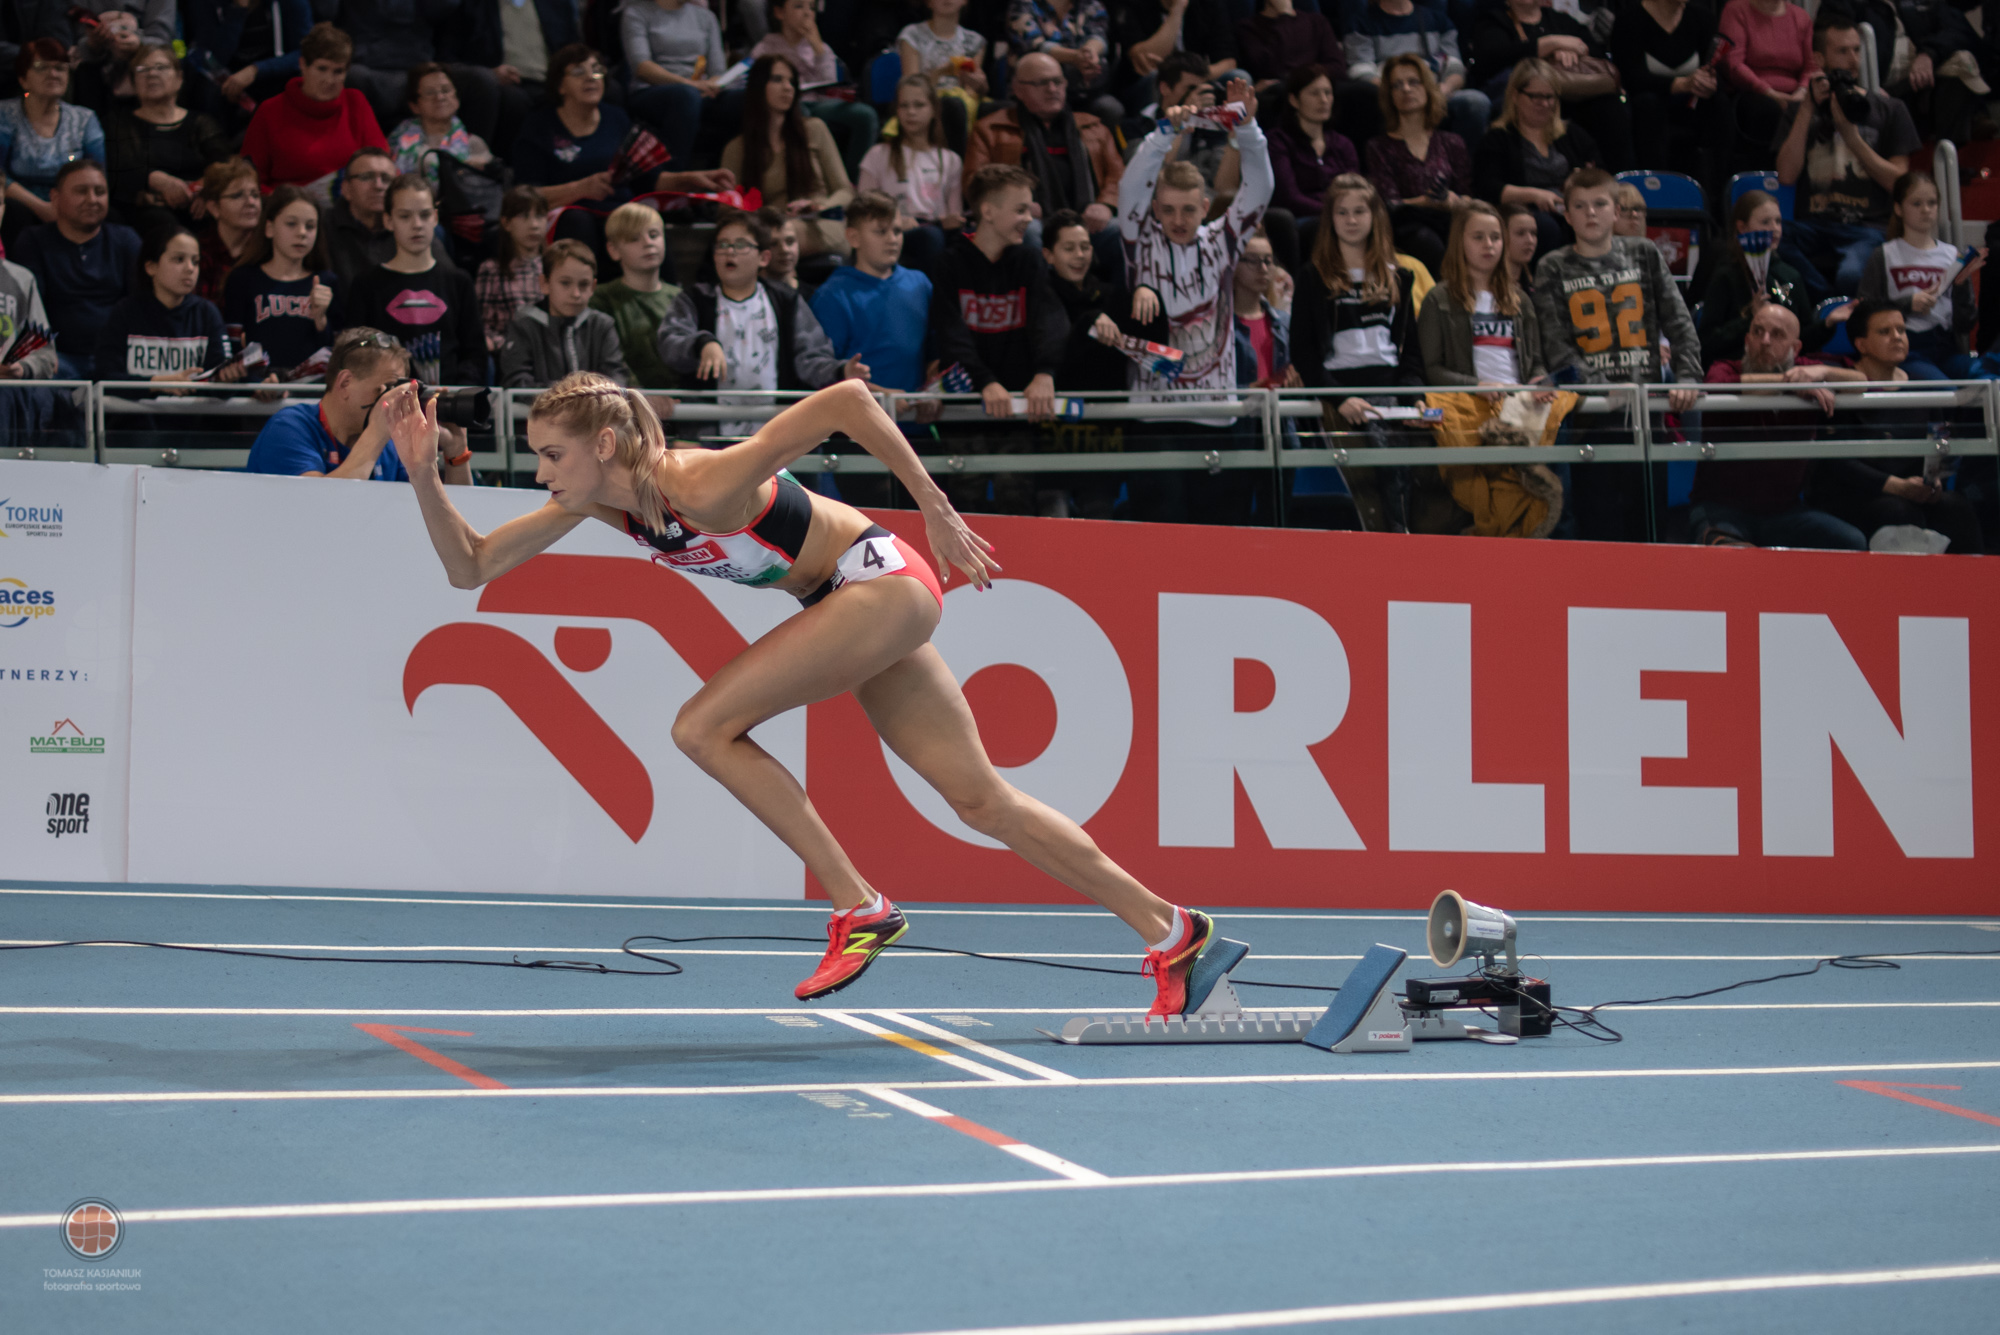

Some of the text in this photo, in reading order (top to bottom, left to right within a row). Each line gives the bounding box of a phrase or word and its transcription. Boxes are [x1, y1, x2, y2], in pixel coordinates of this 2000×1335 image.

[1568, 282, 1648, 353] 92
[5, 503, 63, 523] TORUŃ
[863, 540, 885, 569] 4
[878, 578, 1975, 859] ORLEN
[30, 736, 105, 746] MAT-BUD
[46, 814, 90, 838] sport
[1378, 1032, 1401, 1040] polanik
